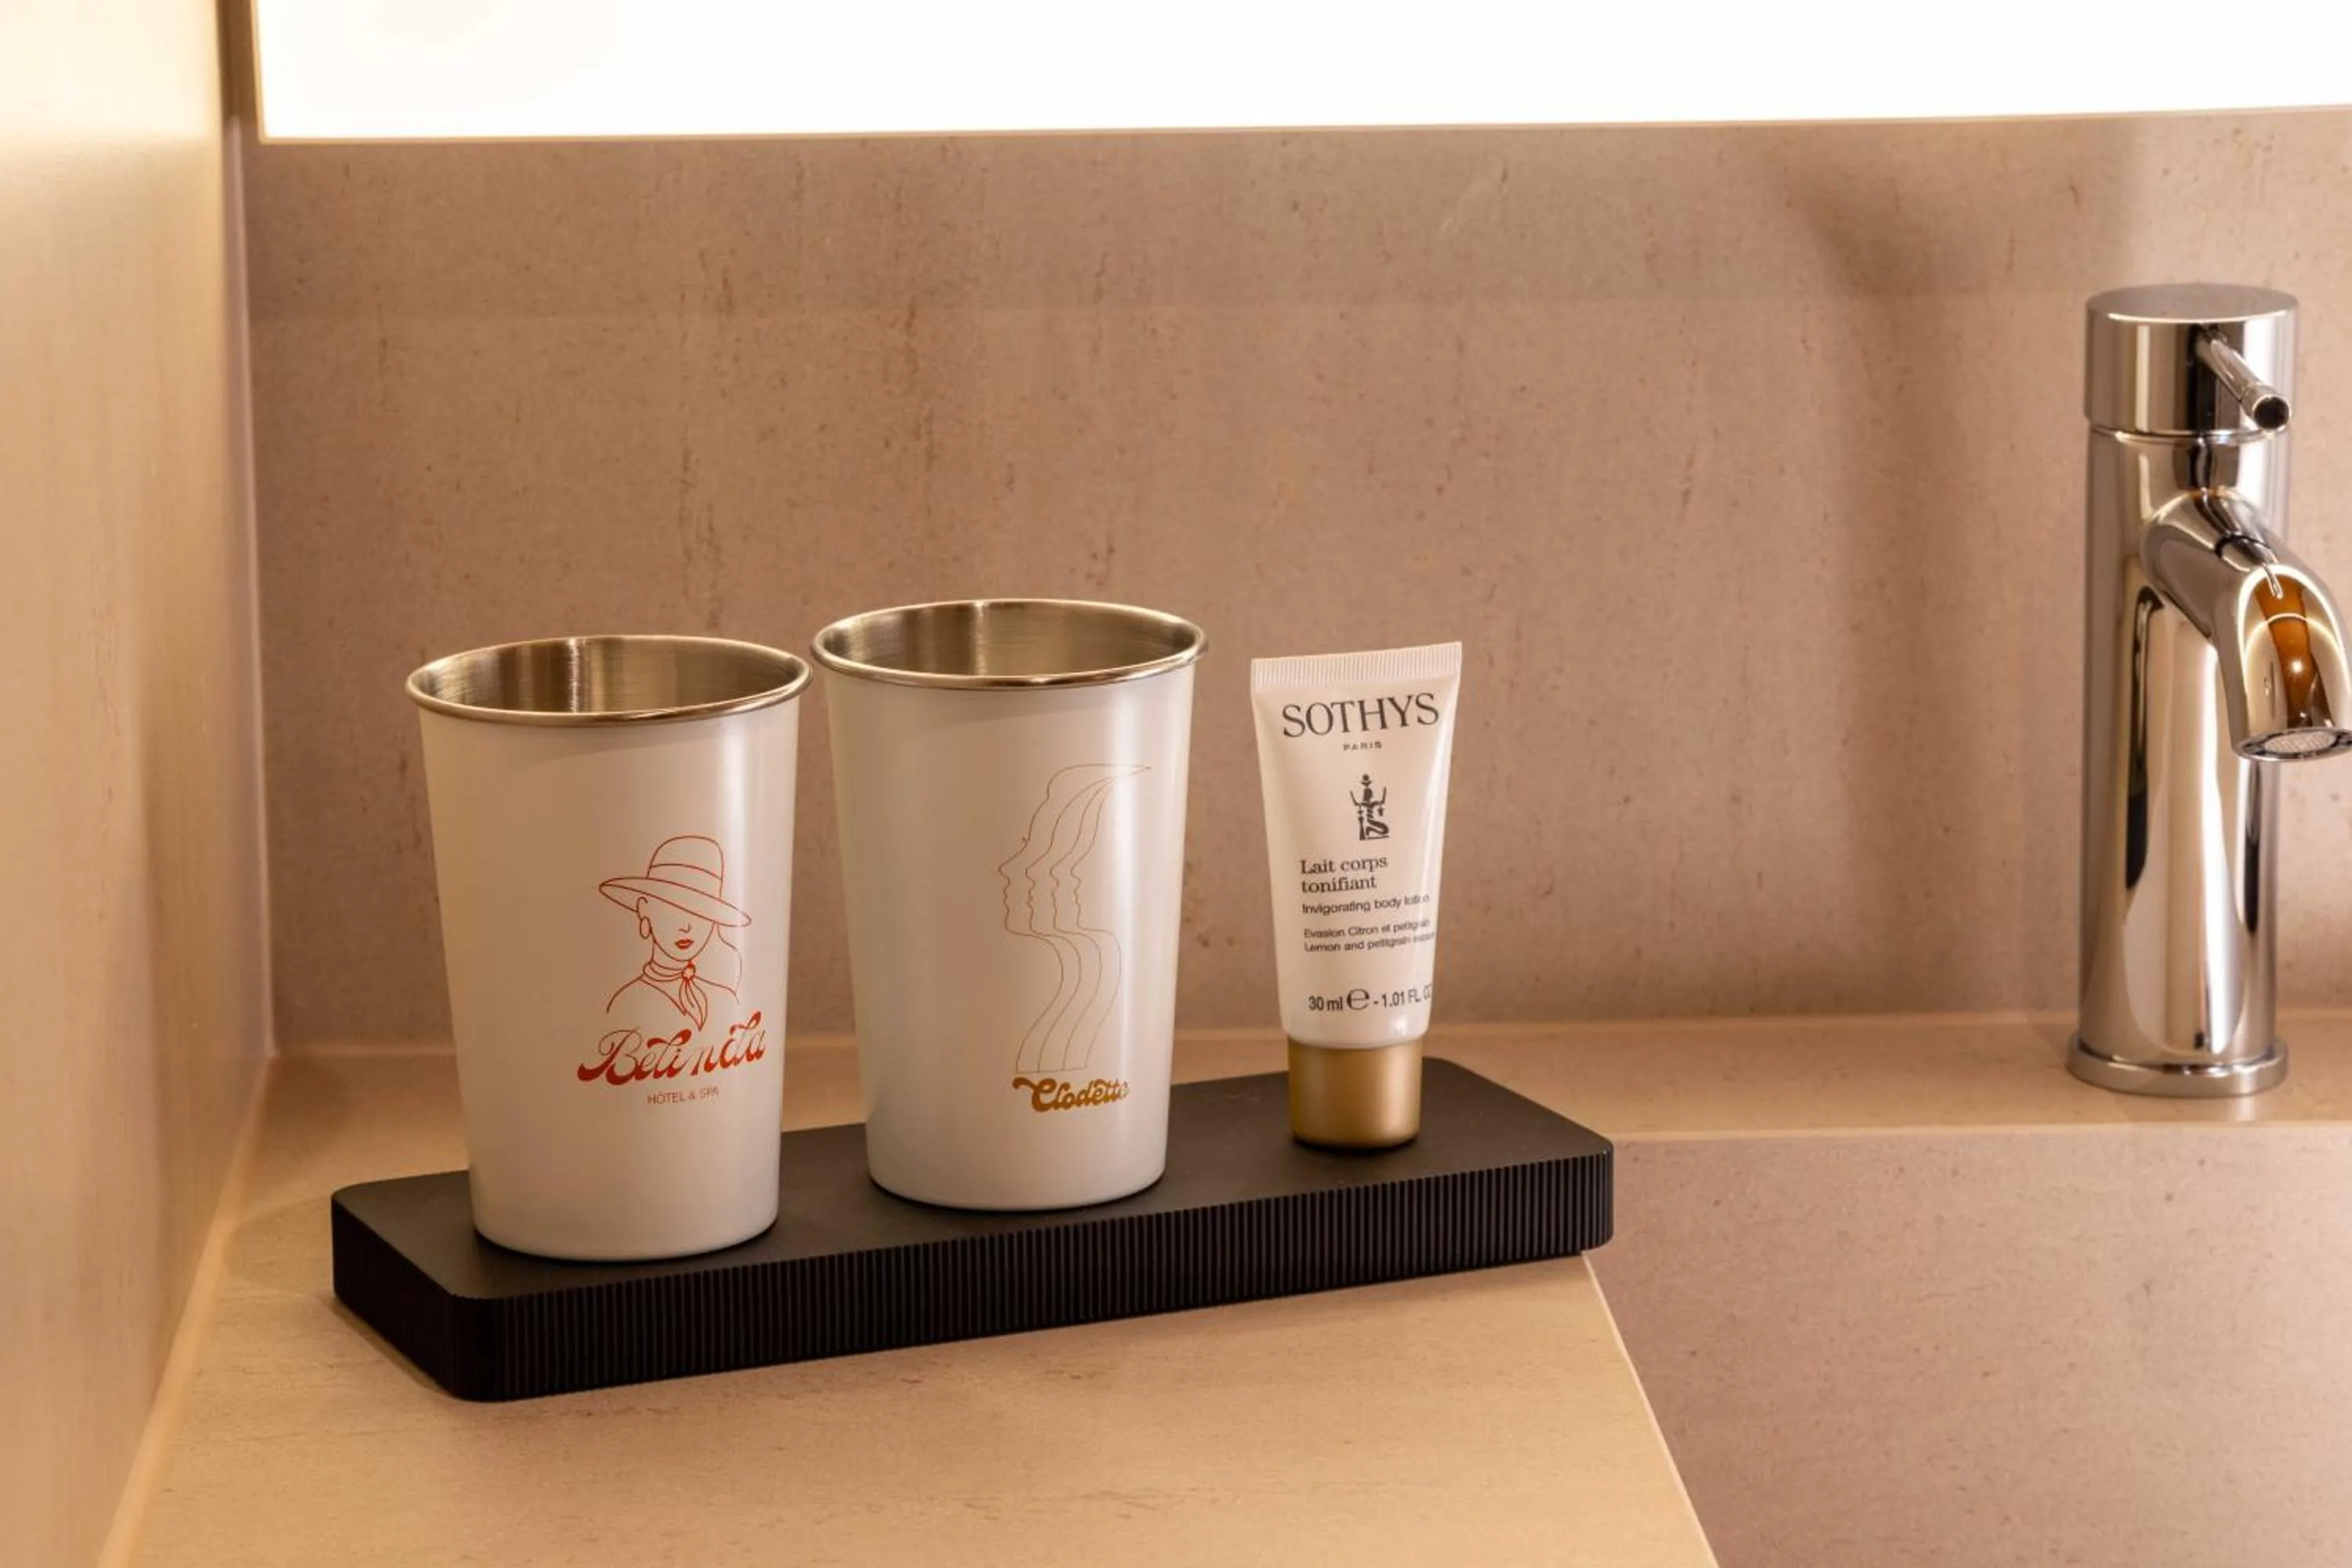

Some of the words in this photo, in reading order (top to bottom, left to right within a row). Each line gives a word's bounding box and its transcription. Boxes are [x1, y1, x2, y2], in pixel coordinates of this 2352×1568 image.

[1282, 692, 1439, 738] SOTHYS
[1343, 741, 1383, 751] PARIS
[1299, 858, 1336, 875] Lait
[1340, 855, 1388, 874] corps
[1301, 876, 1377, 894] tonifiant
[1302, 901, 1371, 916] Invigorating
[1374, 898, 1402, 909] body
[1304, 927, 1345, 938] Evasion
[1348, 926, 1379, 936] Citron
[1381, 924, 1390, 933] et
[1304, 942, 1341, 953] Lemon
[1344, 941, 1366, 951] and
[1308, 995, 1324, 1011] 30
[1327, 996, 1343, 1011] ml
[1381, 989, 1405, 1009] 1.01
[577, 1011, 766, 1086] Belinda
[699, 1086, 720, 1099] SPA
[1011, 1076, 1130, 1112] Clodette
